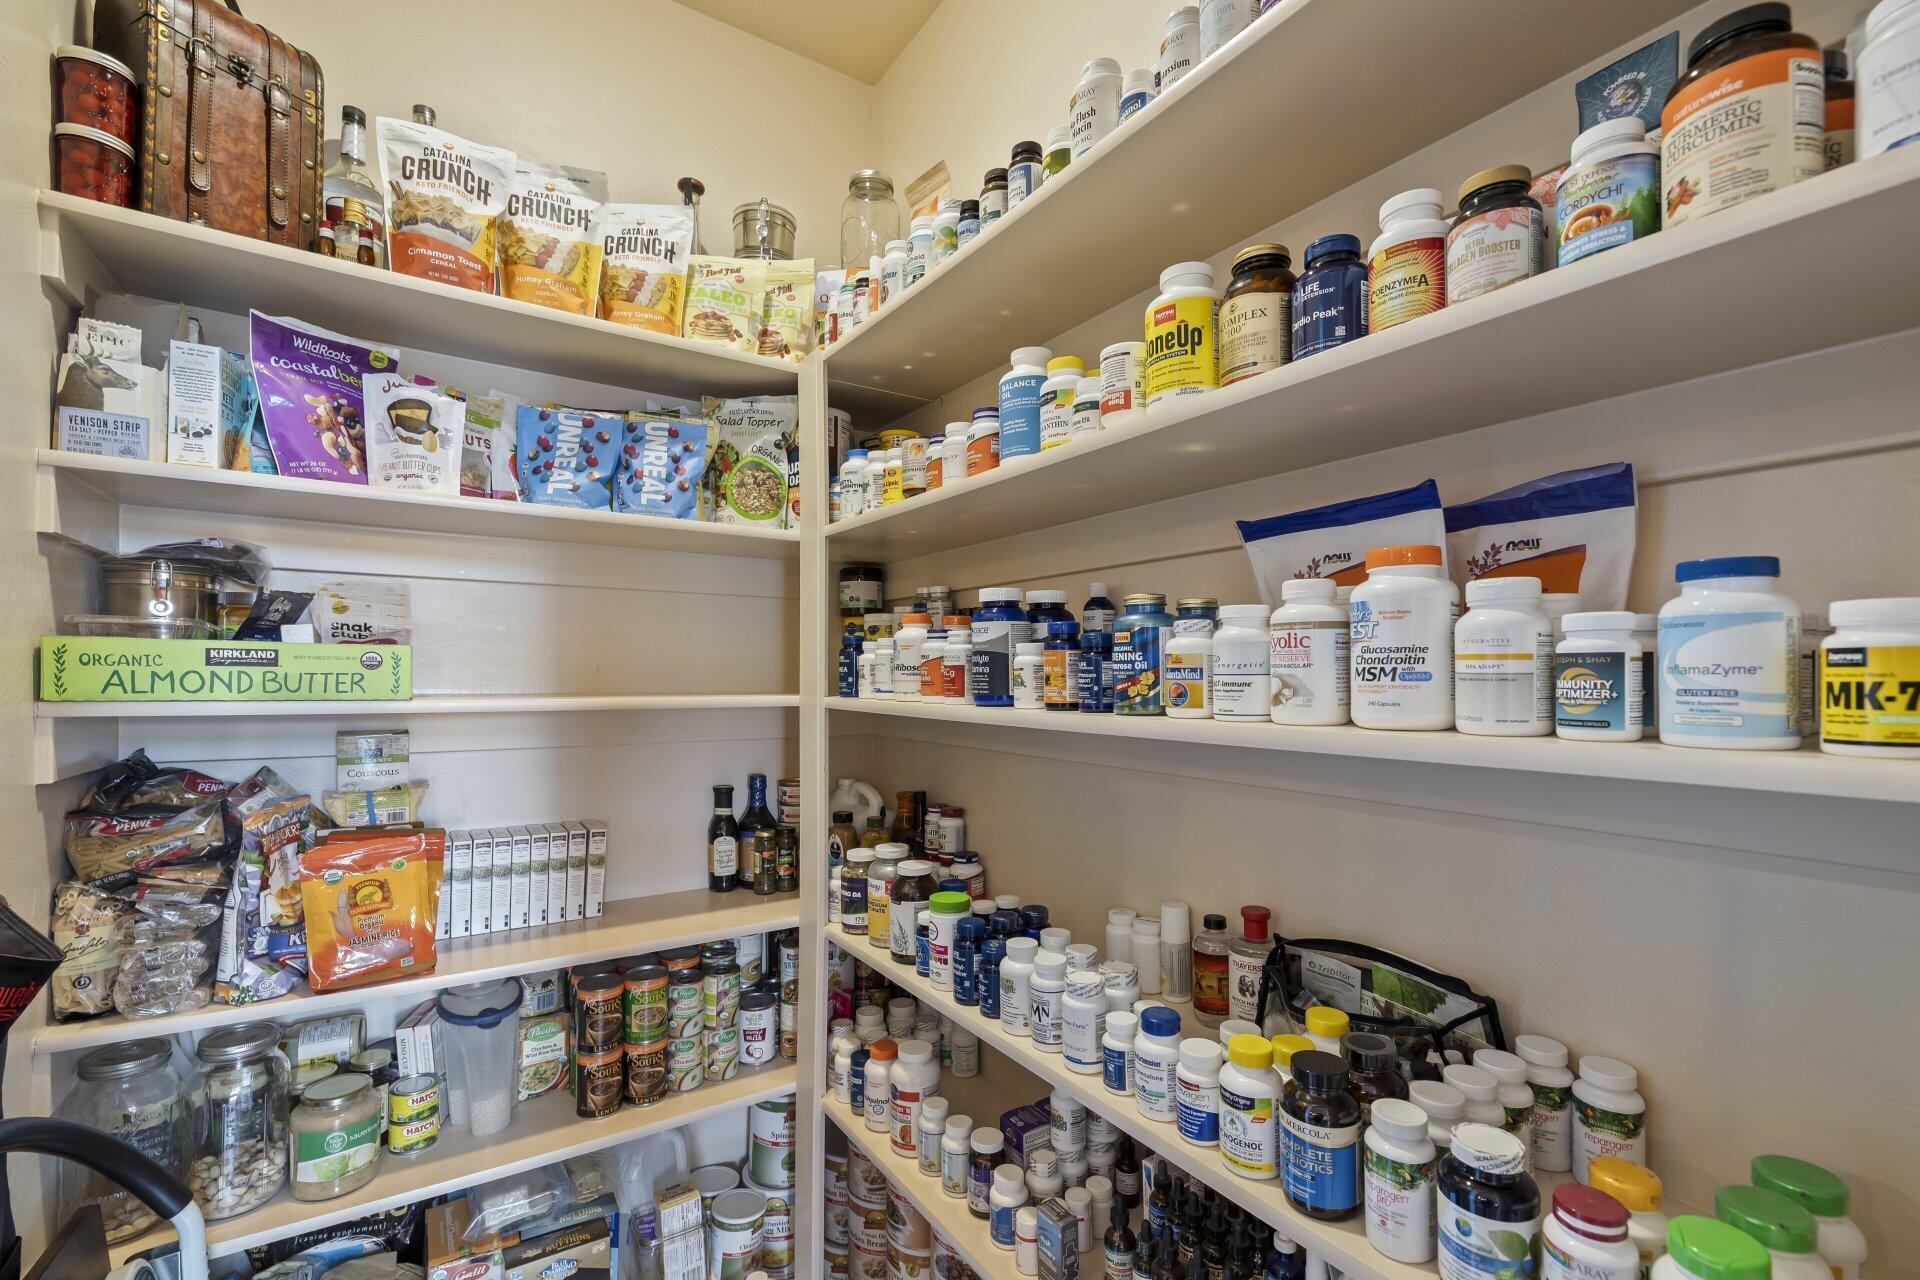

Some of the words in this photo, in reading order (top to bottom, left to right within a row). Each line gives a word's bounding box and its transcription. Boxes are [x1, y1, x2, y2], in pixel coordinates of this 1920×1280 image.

[1602, 71, 1638, 96] POWERED
[1636, 71, 1648, 80] BY
[1075, 106, 1096, 124] Flush
[1666, 99, 1762, 155] TURMERIC
[1666, 112, 1761, 167] CURCUMIN
[423, 147, 472, 169] CATALINA
[401, 155, 492, 206] CRUNCH
[1580, 163, 1618, 183] DEFENSE
[415, 180, 436, 189] KETO
[438, 182, 474, 204] FRIENDLY
[527, 190, 571, 207] CATALINA
[507, 193, 592, 233] CRUNCH
[521, 216, 539, 227] KETO
[540, 218, 576, 234] FRIENDLY
[621, 227, 659, 237] CATALINA
[603, 235, 678, 264] CRUNCH
[1464, 237, 1486, 251] ULTRA
[1478, 239, 1521, 257] BOOSTER
[407, 247, 457, 263] Cinnamon
[457, 254, 483, 272] Toast
[430, 258, 458, 270] CEREAL
[614, 254, 631, 262] KETO
[631, 254, 662, 265] FRIENDLY
[515, 274, 543, 287] Honey
[543, 278, 578, 294] Graham
[1300, 281, 1320, 297] LIFE
[534, 288, 559, 298] CEREAL
[634, 310, 665, 322] Graham
[86, 332, 130, 347] EPIC
[293, 334, 353, 363] WildRoots
[1001, 379, 1037, 392] BALANCE
[1175, 389, 1205, 397] SUPPLEMENT
[1001, 391, 1012, 400] OIL
[68, 414, 108, 429] VENISON
[113, 420, 141, 433] STRIP
[715, 415, 743, 426] Salad
[746, 416, 784, 428] Topper
[97, 428, 118, 437] PEPPER
[463, 434, 491, 450] UTS
[403, 453, 428, 461] chocolate
[545, 412, 583, 495] UNREAL
[751, 444, 784, 467] ORGANIC
[399, 460, 427, 470] BUTTER
[427, 464, 442, 475] CUPS
[640, 421, 670, 505] UNREAL
[395, 472, 424, 481] organic
[1505, 538, 1541, 551] now
[1322, 553, 1351, 564] now
[330, 621, 373, 633] snak
[331, 630, 370, 640] club
[1460, 637, 1511, 645] INTEGRATIVE
[210, 649, 276, 659] KIRKLAND
[1360, 644, 1429, 654] Glucosamine
[78, 652, 164, 667] ORGANIC
[1134, 661, 1148, 670] Oil
[1278, 654, 1312, 662] RESERVE
[1355, 654, 1426, 665] Chondroitin
[1585, 656, 1612, 664] SHAY
[1355, 666, 1398, 682] MSM
[1400, 672, 1431, 681] OptiMSM
[101, 670, 254, 695] ALMOND
[262, 670, 367, 695] BUTTER
[1826, 680, 1920, 712] MK-7
[346, 766, 400, 778] Couscous
[115, 818, 152, 833] PENNE
[355, 880, 381, 890] PREMIUM
[357, 913, 385, 922] Premium
[359, 920, 385, 930] Organic
[348, 933, 382, 946] JASMINE
[383, 928, 400, 939] RICE
[1232, 959, 1263, 972] THAYERS
[634, 986, 667, 1005] SOUPS
[589, 997, 622, 1015] SOUPS
[676, 1003, 698, 1012] Chicken
[530, 1023, 561, 1038] Pacific
[746, 1034, 764, 1042] milk
[525, 1051, 537, 1060] Wild
[537, 1050, 549, 1058] Rice
[550, 1046, 564, 1056] Soup
[530, 1044, 551, 1053] Chicken
[631, 1050, 664, 1067] SOUPS
[673, 1057, 696, 1066] Chicken
[590, 1059, 622, 1079] SOUPS
[411, 1087, 438, 1106] HATCH
[1189, 1100, 1210, 1109] Memory
[406, 1120, 435, 1137] HATCH
[1285, 1120, 1330, 1140] MERCOLA
[1584, 1131, 1634, 1152] reparagen
[1600, 1146, 1617, 1157] pro
[1376, 1193, 1392, 1207] pro
[559, 1206, 602, 1223] NUT-THINS
[776, 1225, 791, 1234] Mix
[546, 1232, 591, 1253] NUT-THINS
[542, 1260, 577, 1276] DIAMOND
[551, 1259, 570, 1269] BLUE
